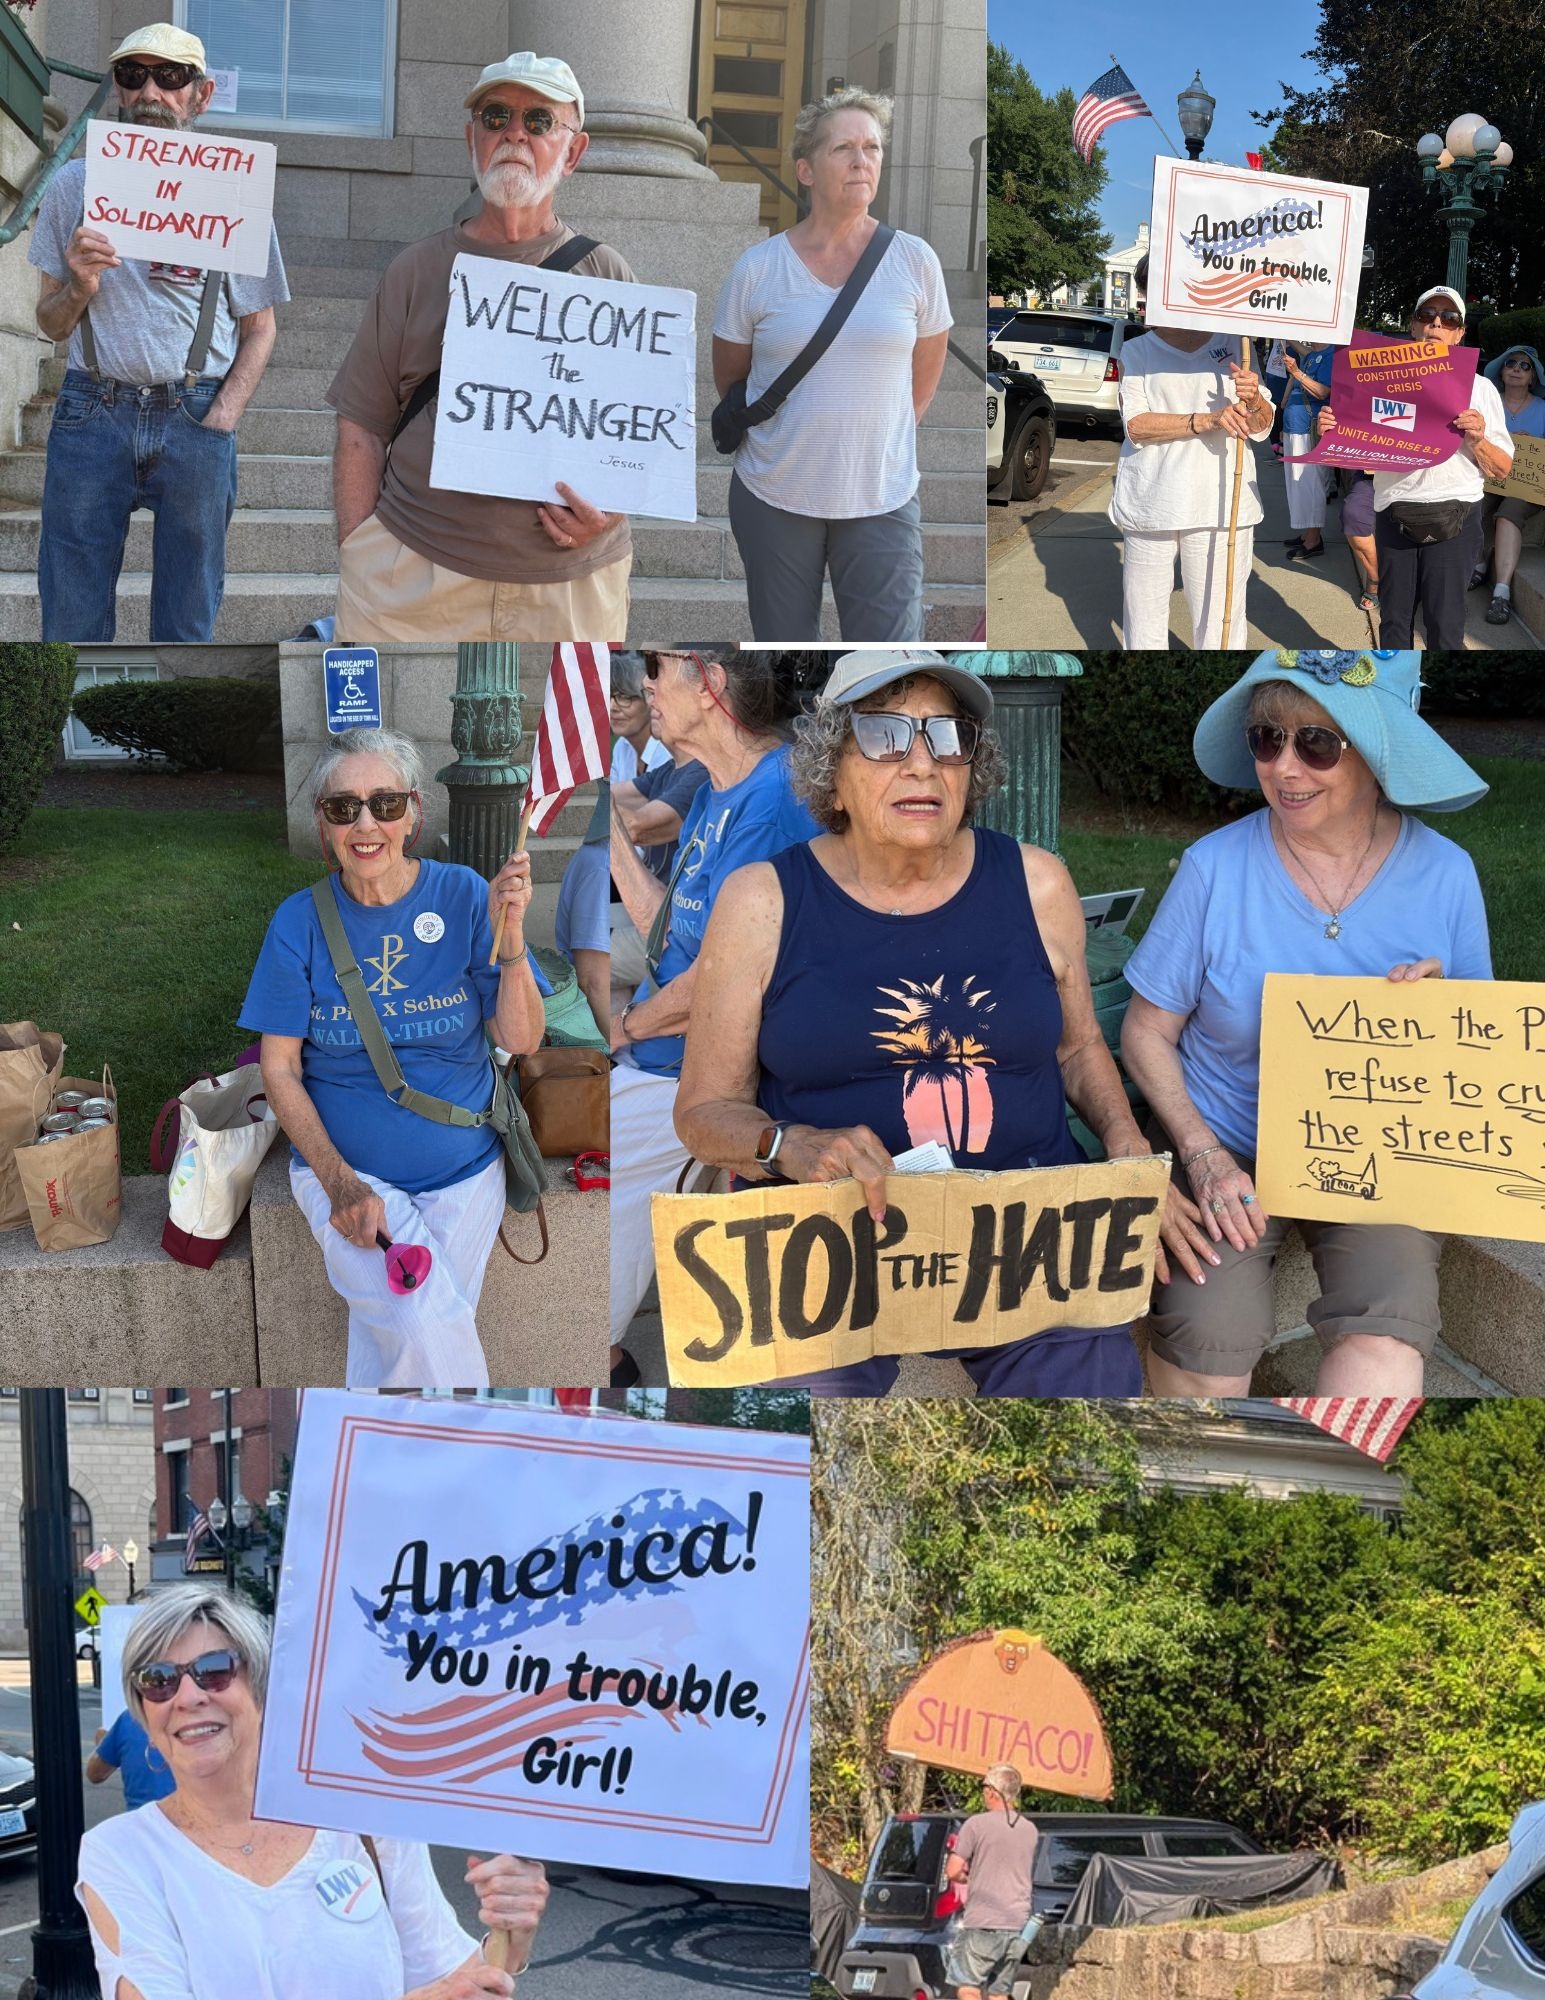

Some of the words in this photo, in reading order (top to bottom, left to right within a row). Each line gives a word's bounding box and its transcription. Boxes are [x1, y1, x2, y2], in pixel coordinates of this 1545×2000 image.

[101, 131, 255, 174] STRENGTH
[156, 179, 183, 201] IN
[88, 196, 244, 248] SOLIDARITY
[1189, 200, 1323, 245] America!
[1202, 248, 1234, 271] You
[1240, 254, 1256, 274] in
[1262, 257, 1331, 285] trouble,
[1249, 289, 1288, 312] Girl!
[541, 352, 584, 383] the
[1355, 342, 1437, 367] WARNING
[1356, 362, 1454, 383] CONSTITUTIONAL
[1386, 382, 1423, 393] CRISIS
[1374, 398, 1408, 416] LWV
[1327, 444, 1344, 452] 8.5
[1343, 446, 1389, 460] MILLION
[1390, 455, 1433, 464] VOICES
[1337, 425, 1370, 442] UNITE
[1370, 434, 1395, 447] AND
[1397, 440, 1422, 452] RISE
[1423, 447, 1441, 455] 8.5
[600, 455, 645, 471] Jesus
[328, 660, 374, 668] HANDICAPPED
[339, 667, 365, 676] ACCESS
[404, 987, 469, 1015] School
[1296, 1000, 1435, 1041] When
[1451, 1006, 1503, 1041] the
[1325, 1057, 1431, 1104] refuse
[1443, 1071, 1482, 1100] to
[1299, 1110, 1363, 1147] the
[1382, 1115, 1513, 1157] streets
[673, 1205, 908, 1363] STOP
[881, 1252, 966, 1291] THE
[953, 1196, 1159, 1323] HATE
[373, 1491, 764, 1622] America!
[405, 1629, 489, 1687] You
[505, 1644, 551, 1696] in
[566, 1651, 767, 1726] trouble,
[522, 1737, 634, 1795] Girl!
[316, 1865, 362, 1906] LWV
